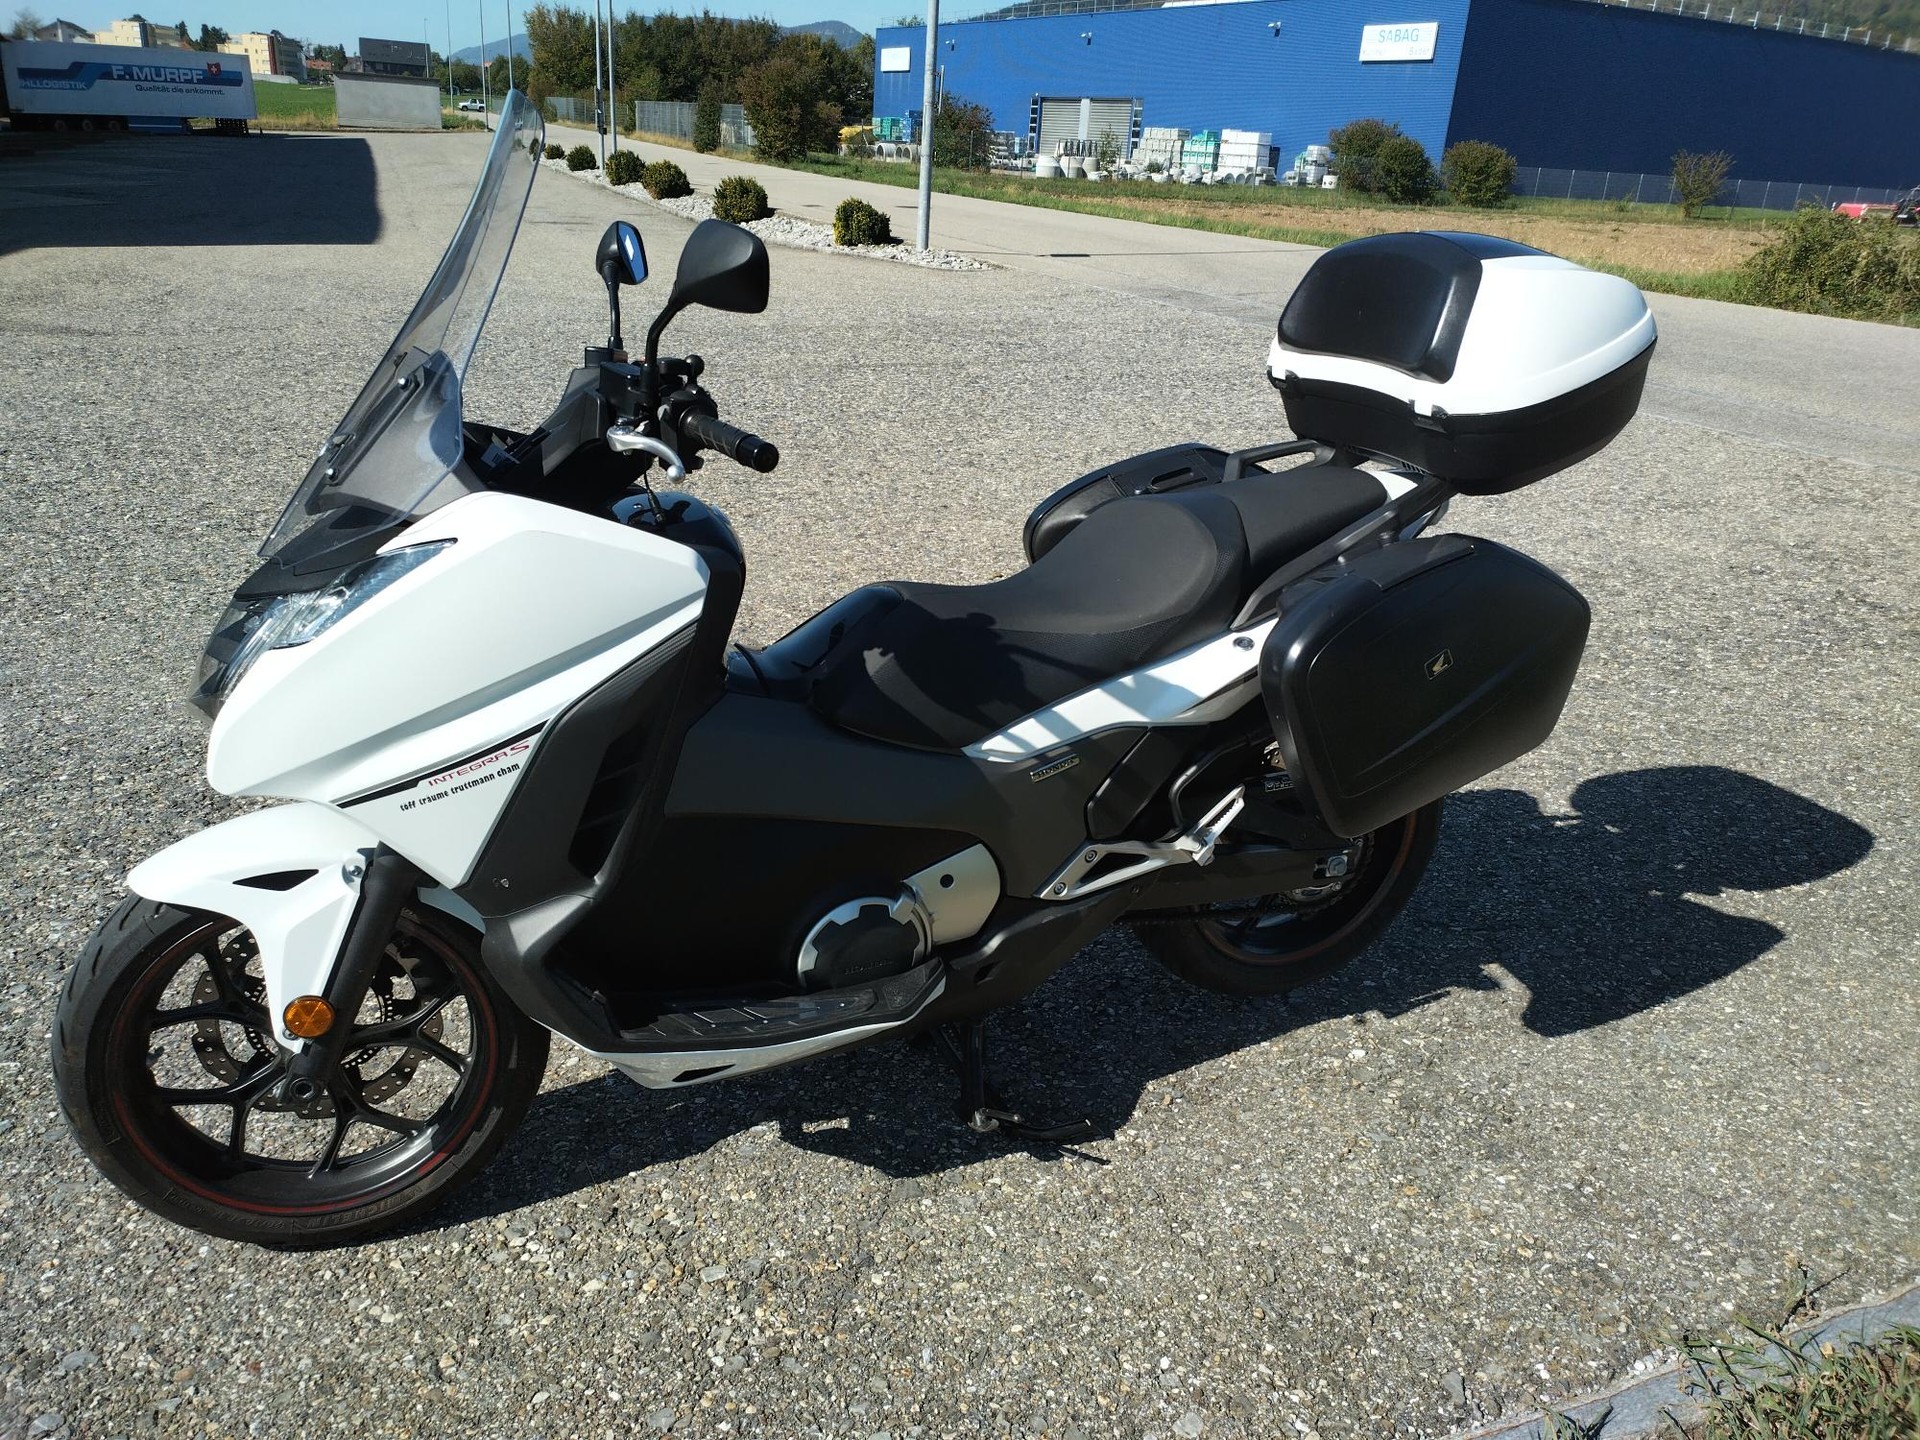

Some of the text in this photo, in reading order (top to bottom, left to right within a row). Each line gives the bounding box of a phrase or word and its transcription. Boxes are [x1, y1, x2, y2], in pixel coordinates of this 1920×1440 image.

[1378, 28, 1420, 43] SABAG
[428, 751, 508, 787] INTEGRA
[450, 772, 495, 794] truttmann
[497, 763, 520, 777] cham
